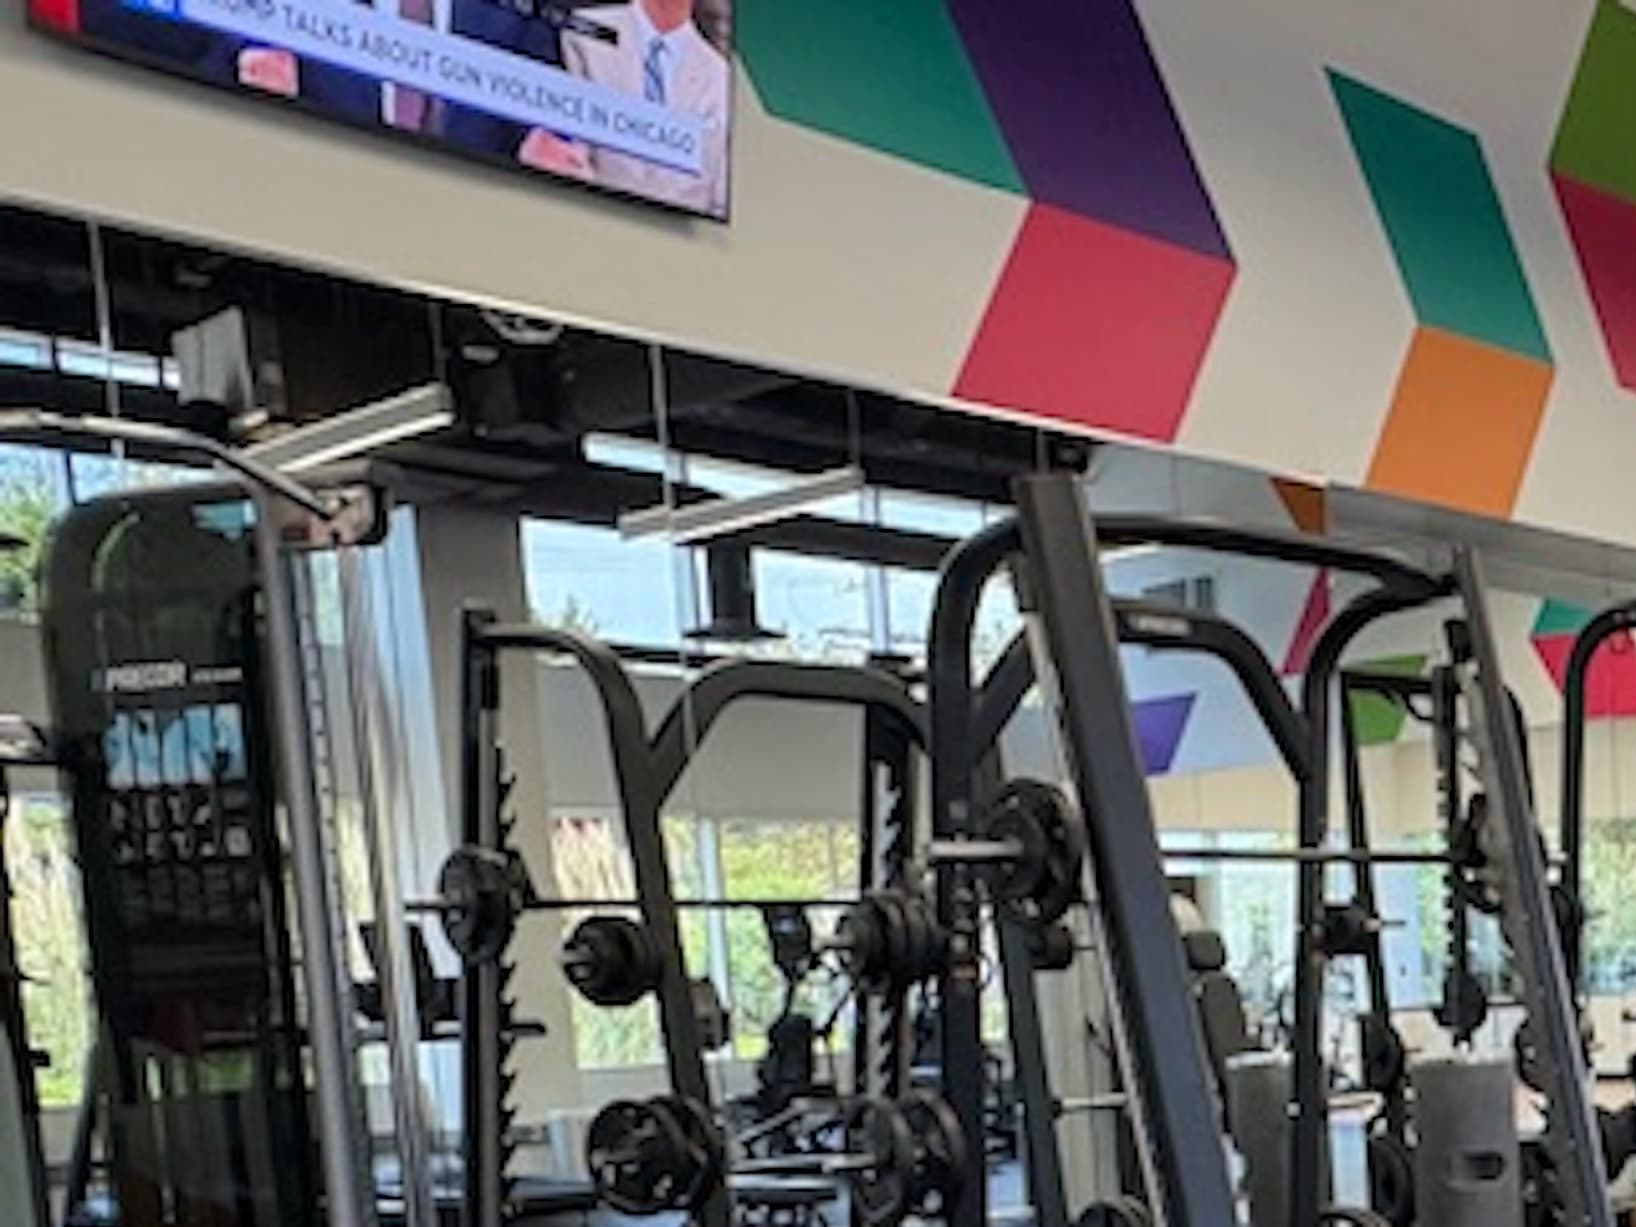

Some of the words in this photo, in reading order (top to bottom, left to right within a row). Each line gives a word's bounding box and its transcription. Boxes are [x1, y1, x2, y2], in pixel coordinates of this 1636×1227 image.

[283, 6, 351, 46] TALKS
[360, 31, 431, 70] ABOUT
[440, 57, 480, 86] GUN
[489, 74, 583, 123] VIOLENCE
[591, 106, 608, 127] IN
[613, 112, 695, 154] CHICAGO
